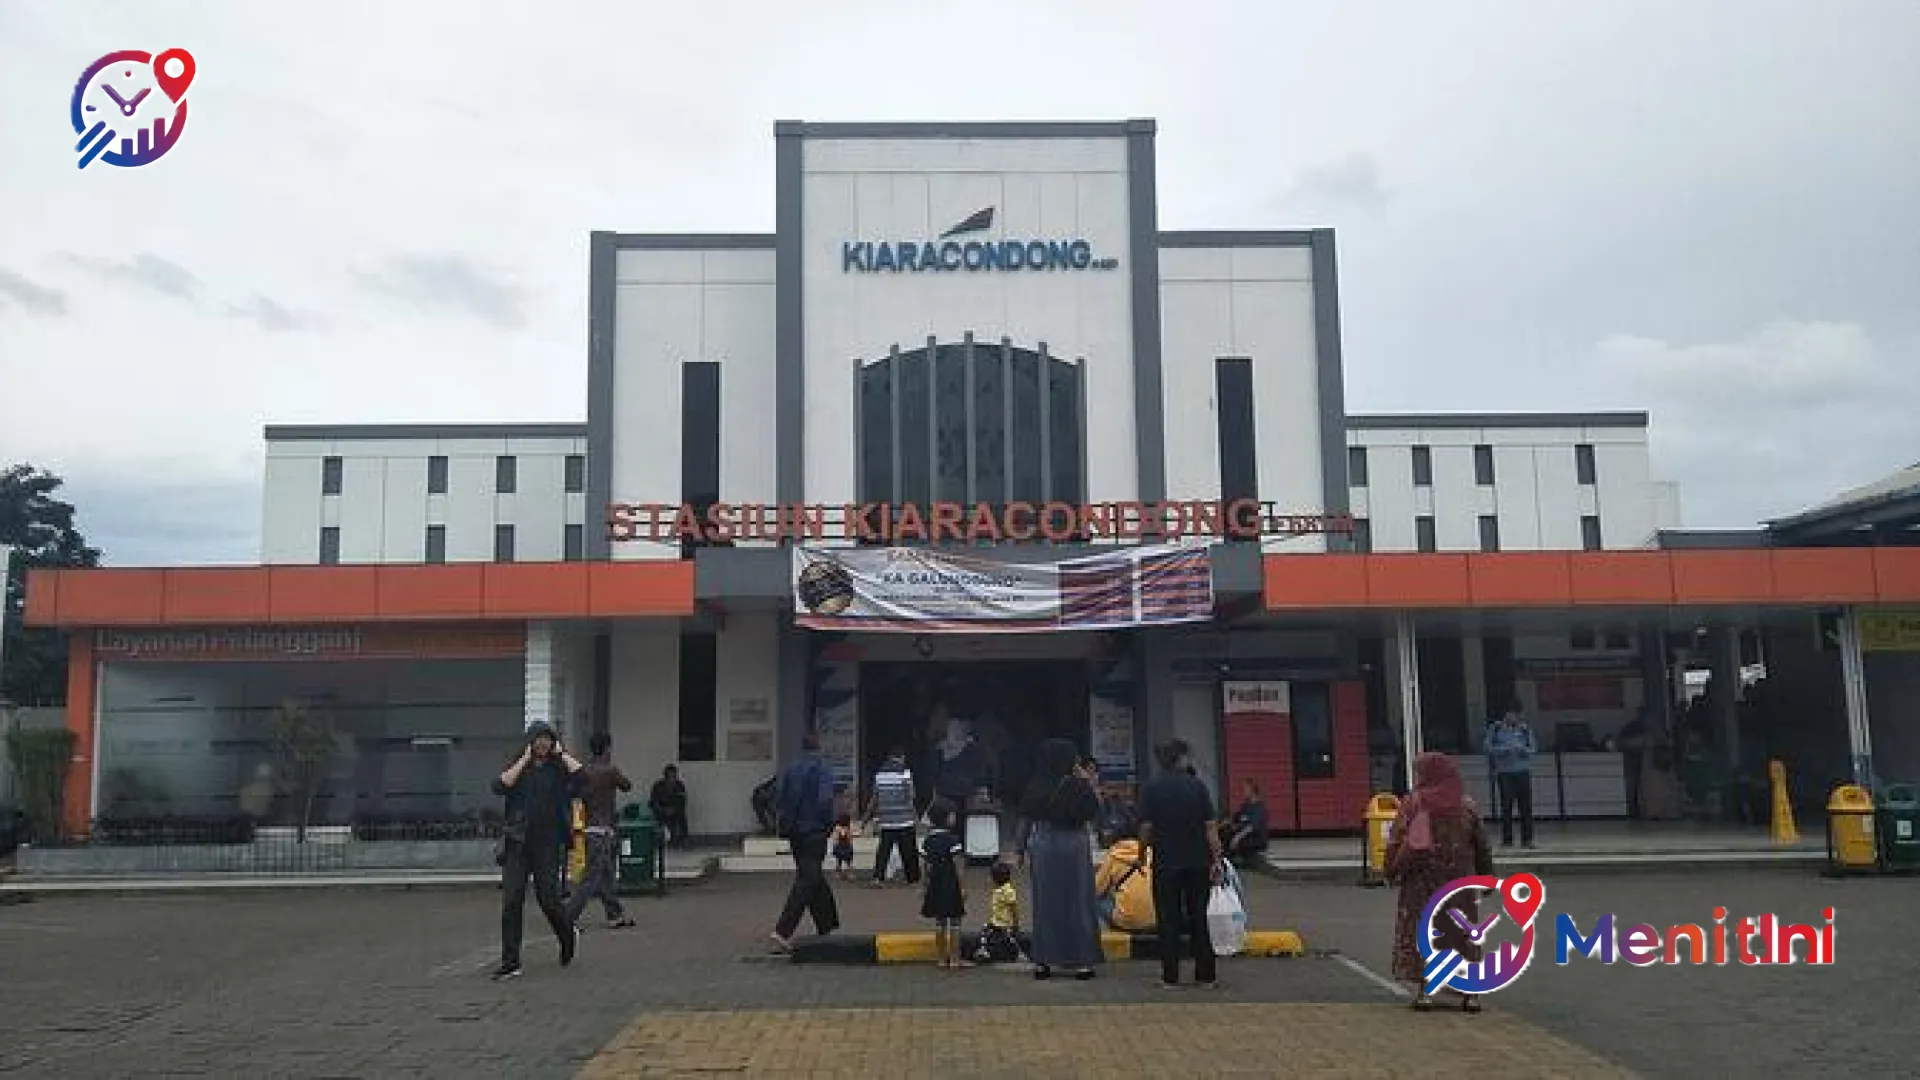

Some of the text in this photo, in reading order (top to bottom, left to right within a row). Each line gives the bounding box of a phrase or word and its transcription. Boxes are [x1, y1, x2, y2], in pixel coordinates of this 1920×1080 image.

[842, 240, 1092, 272] KIARACONDONG
[609, 502, 824, 542] STASIUN
[844, 499, 1261, 542] KIARACONDONG
